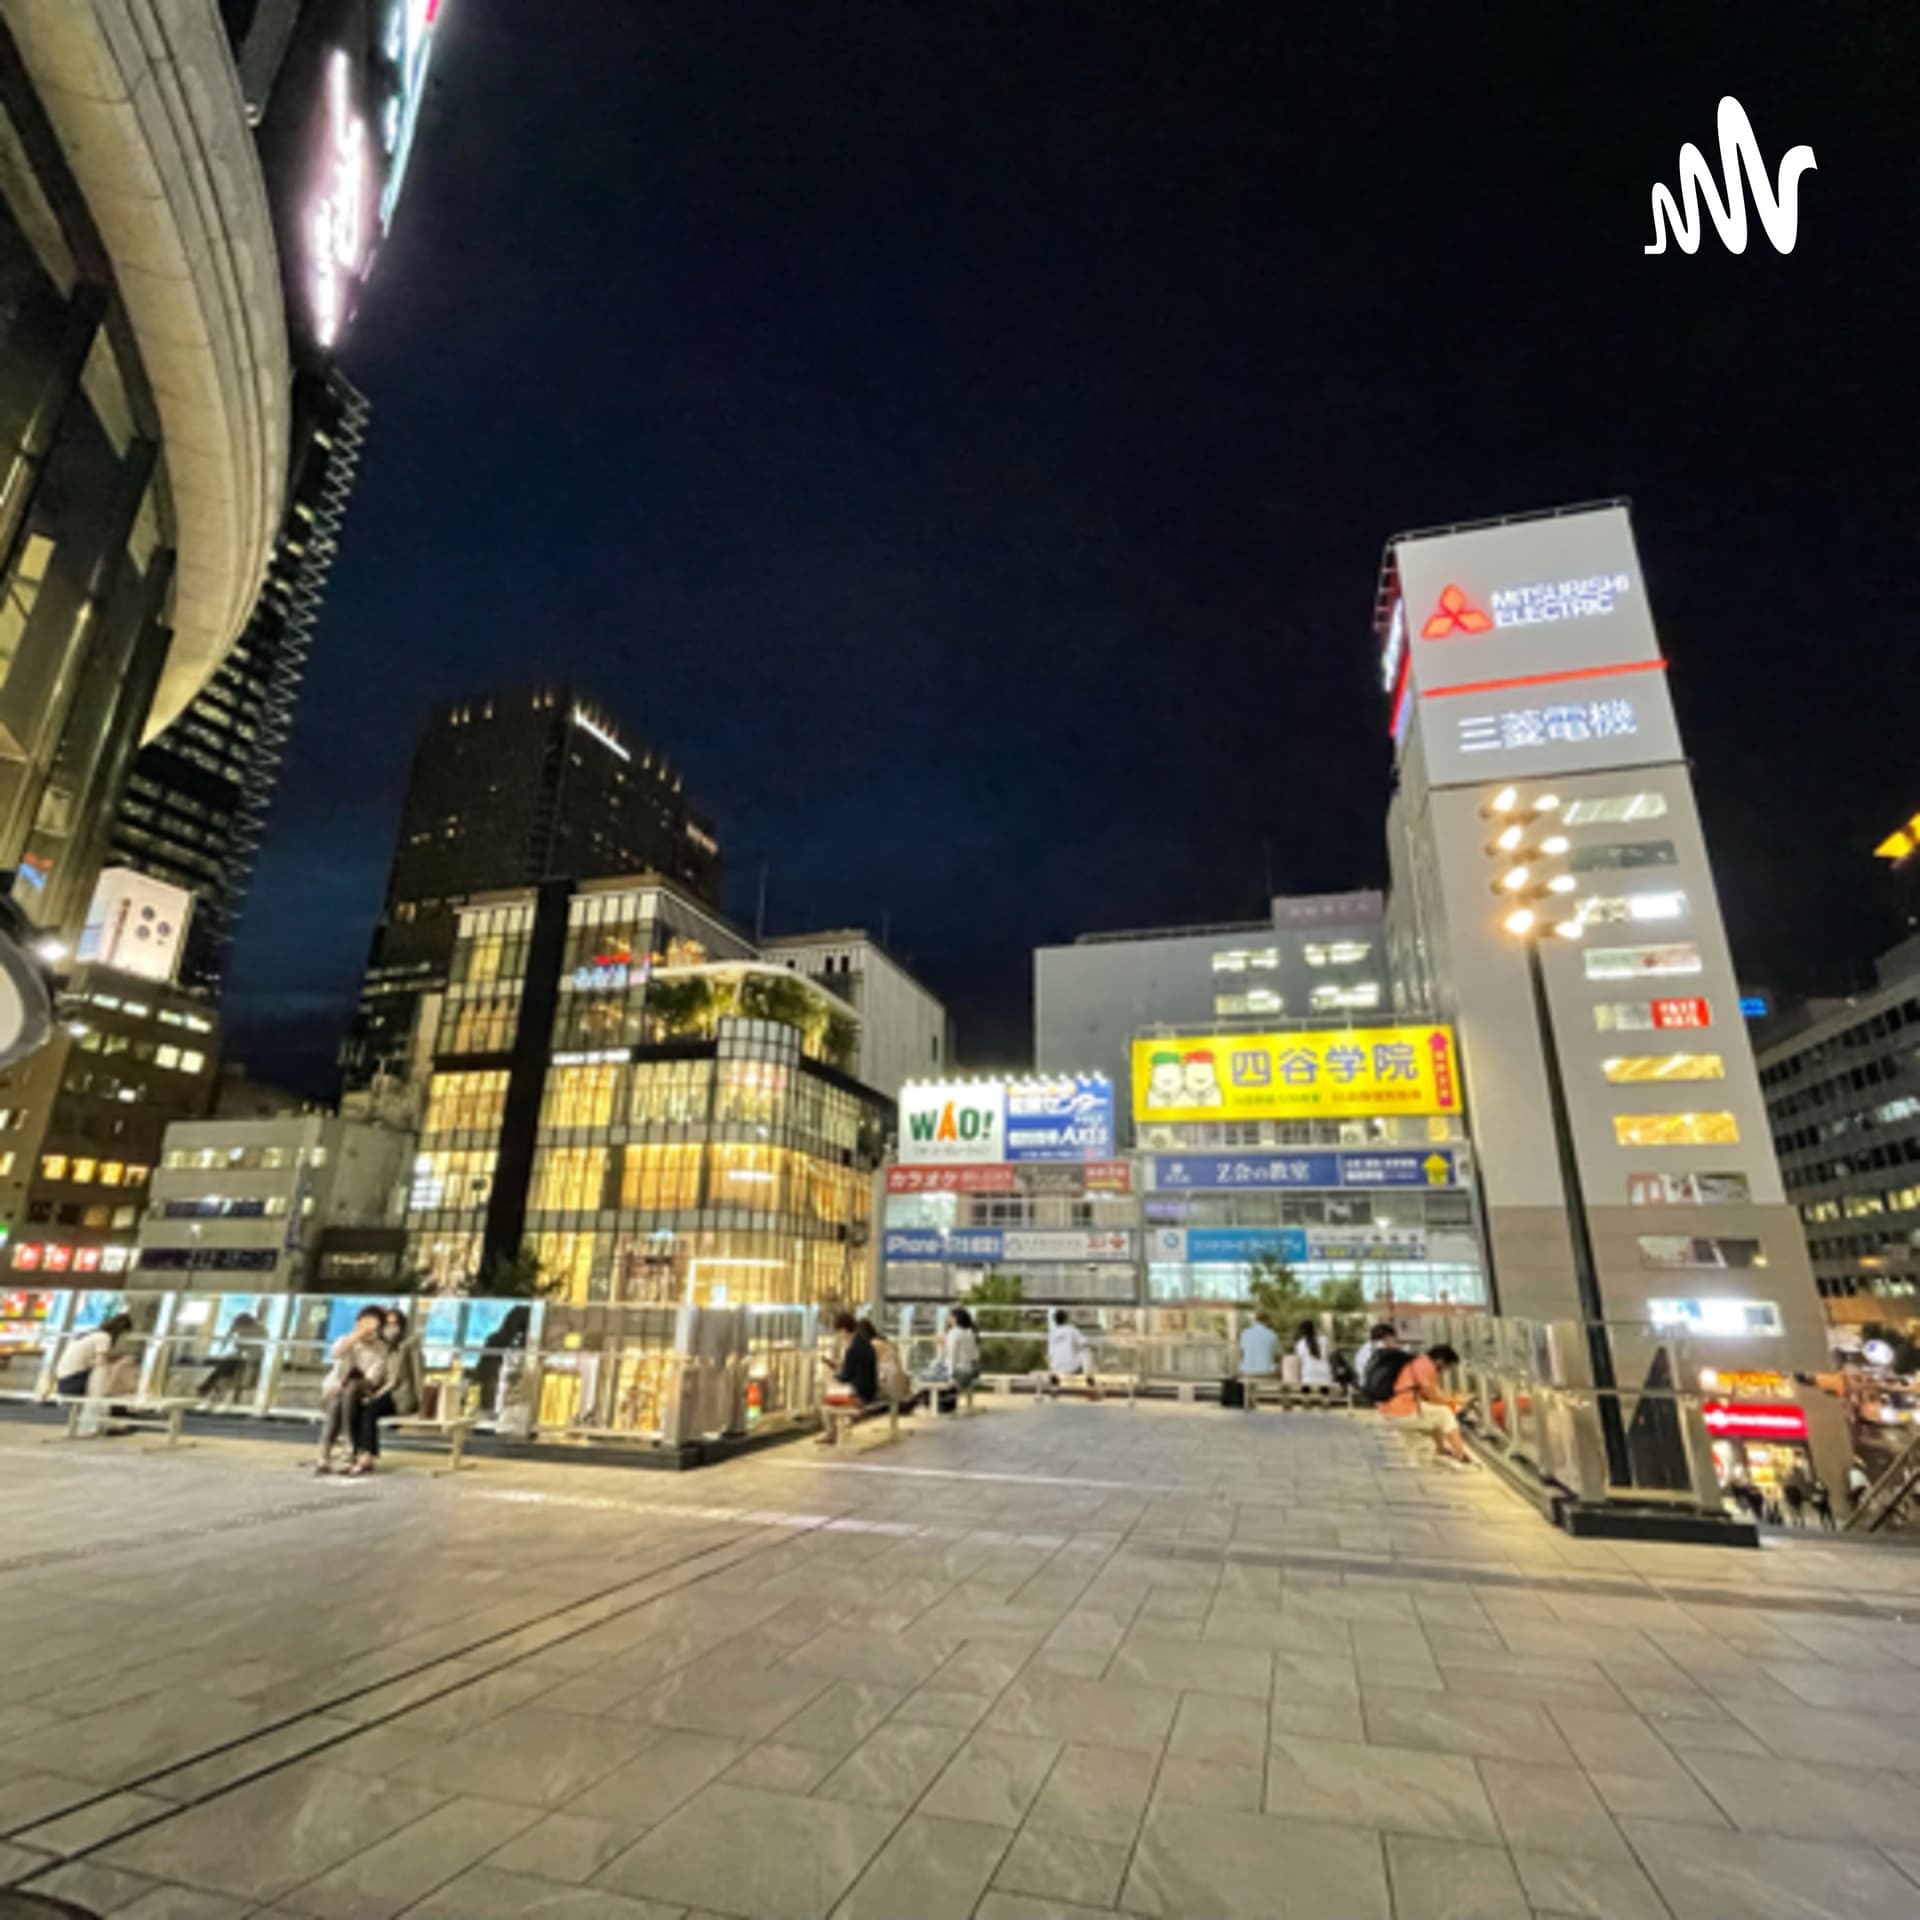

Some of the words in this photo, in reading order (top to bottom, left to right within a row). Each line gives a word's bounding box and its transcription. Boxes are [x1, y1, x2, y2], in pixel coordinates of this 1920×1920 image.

[1491, 574, 1630, 607] MITSUBISHI
[1495, 595, 1615, 627] ELECTRIC
[1457, 697, 1637, 752] 三菱電機
[1231, 1041, 1418, 1086] 四谷学院
[909, 1099, 994, 1141] WAO!
